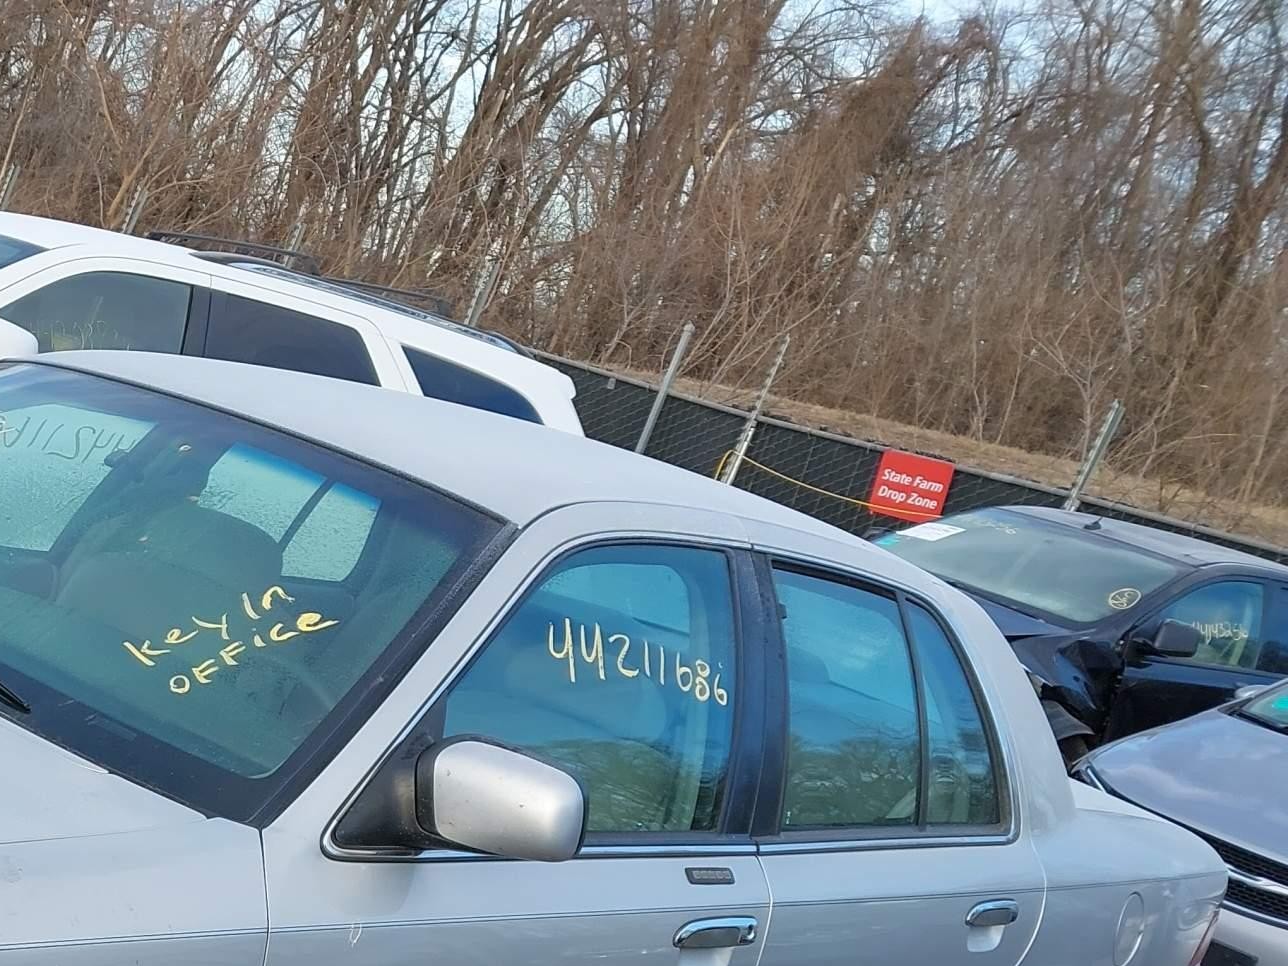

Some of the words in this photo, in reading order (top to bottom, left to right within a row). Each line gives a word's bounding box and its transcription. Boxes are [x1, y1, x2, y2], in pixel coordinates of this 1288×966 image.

[882, 468, 912, 486] State
[914, 476, 944, 493] Farm
[878, 485, 907, 503] Drop
[907, 492, 938, 510] Zone
[548, 617, 728, 706] 44211686
